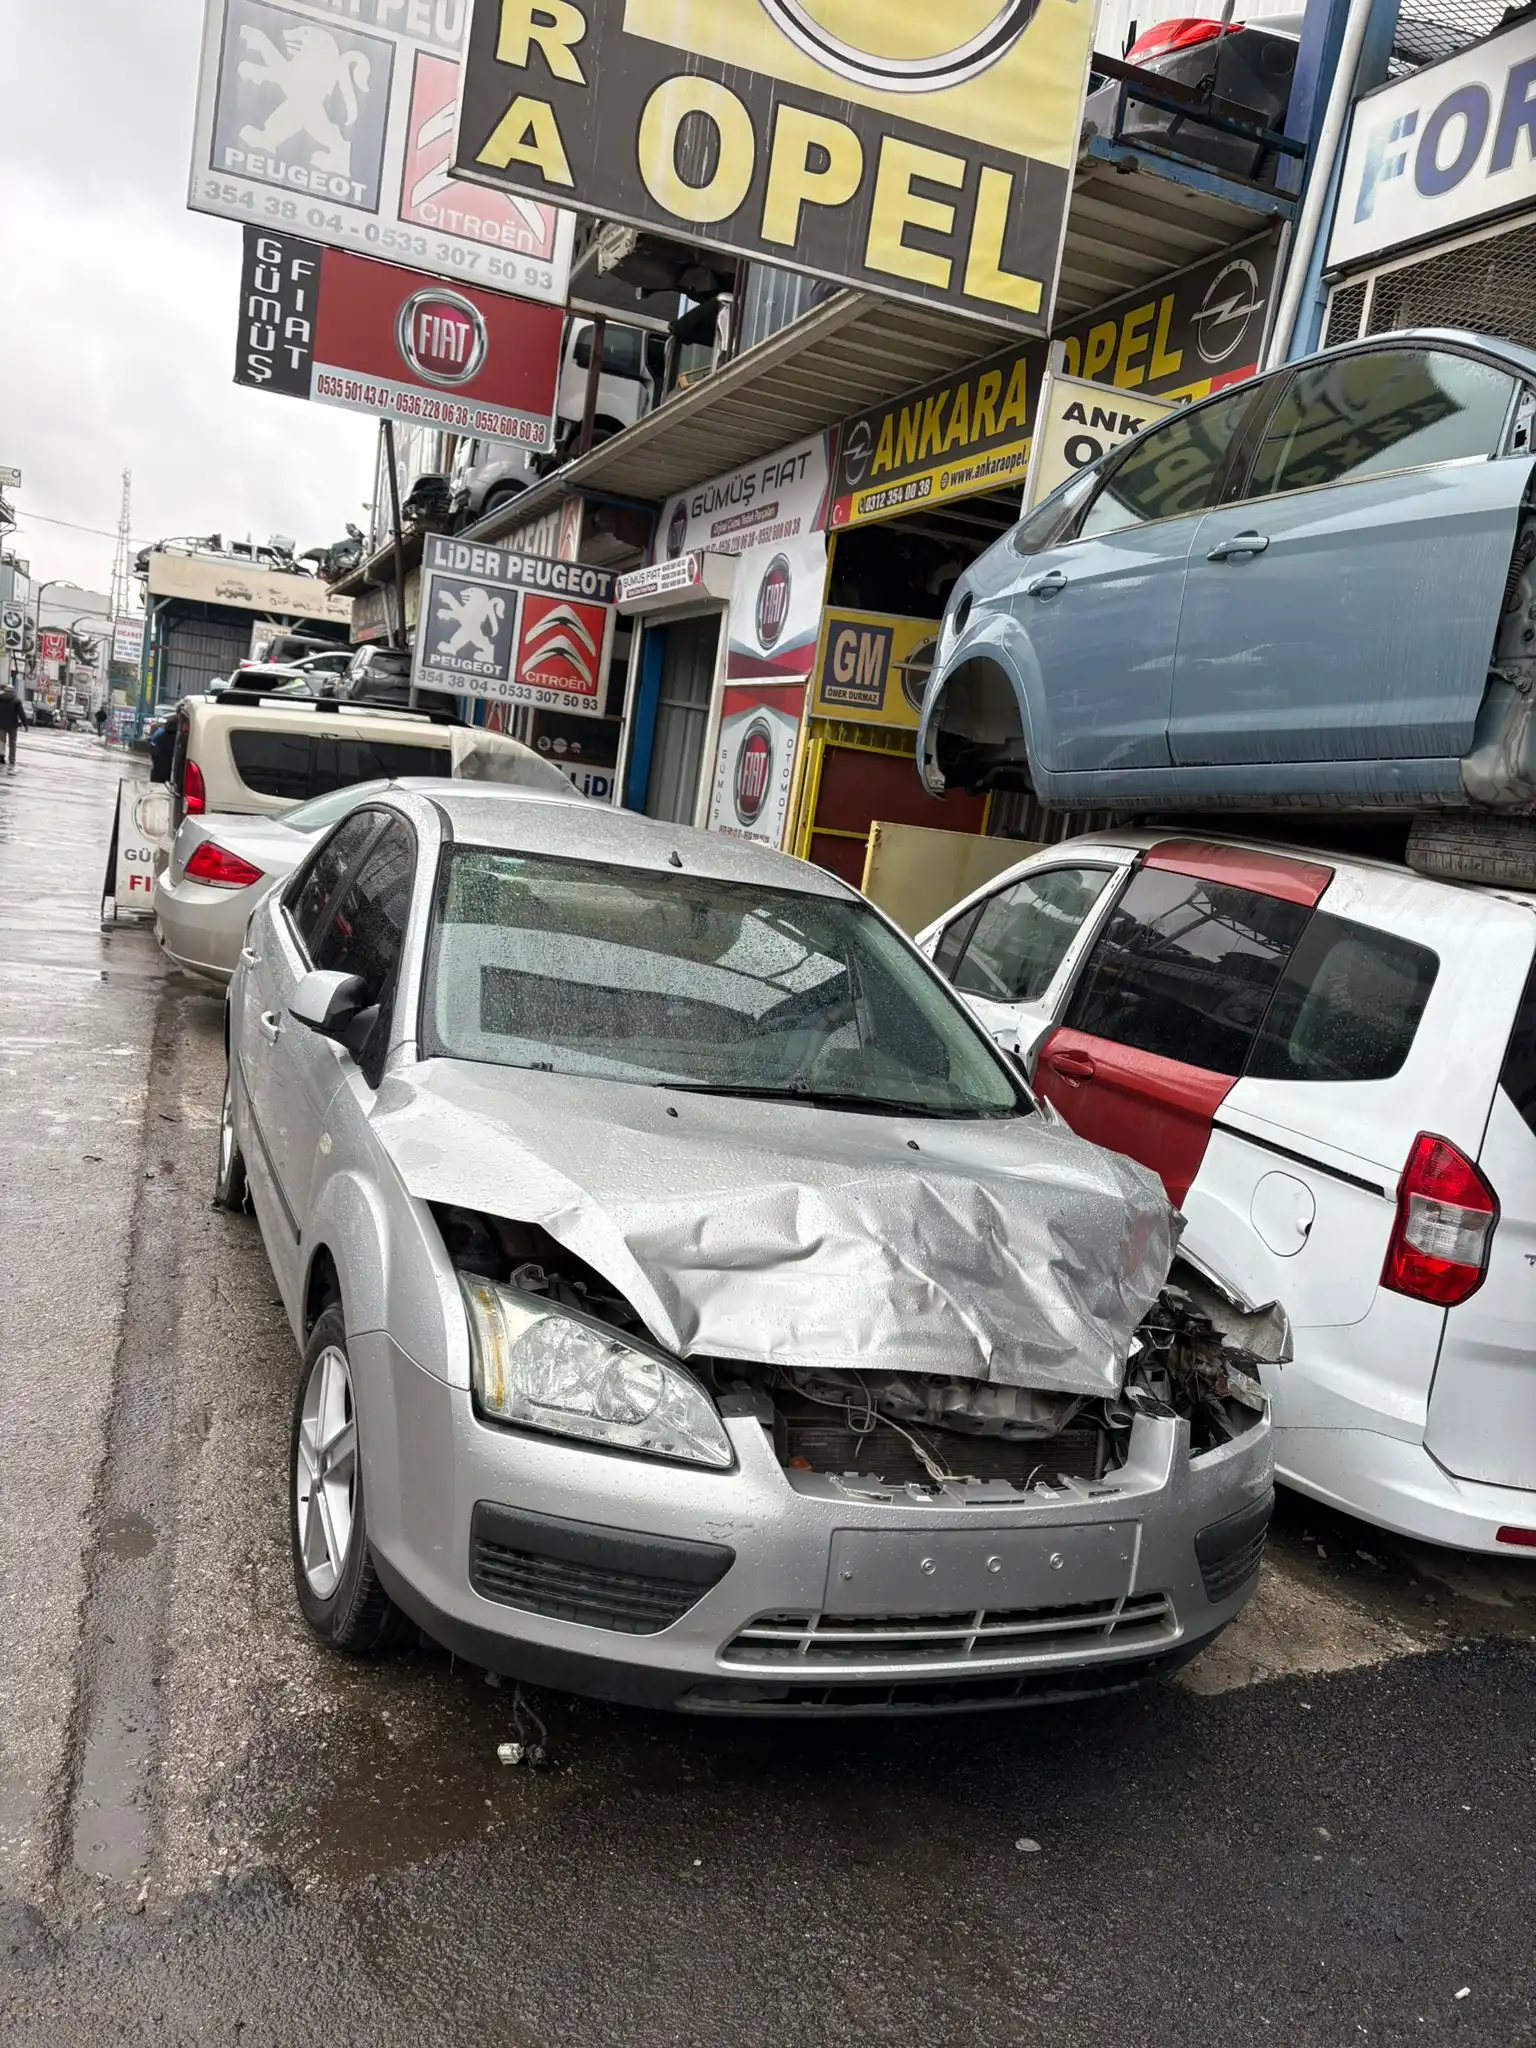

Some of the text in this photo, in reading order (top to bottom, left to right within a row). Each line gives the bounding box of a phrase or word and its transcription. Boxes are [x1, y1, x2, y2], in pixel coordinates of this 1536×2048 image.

[224, 147, 367, 202] PEUGEOT
[637, 74, 1044, 315] OPEL
[204, 180, 255, 209] 354
[264, 196, 297, 220] 38
[307, 208, 343, 233] 04
[365, 223, 428, 256] 0533
[436, 243, 482, 270] 307
[488, 256, 517, 280] 50
[524, 267, 553, 290] 93
[247, 238, 283, 383] GÜMÜŞ
[284, 259, 315, 369] FIAT
[418, 313, 470, 363] FIAT
[317, 373, 546, 444] 0535 501 43 47 0536 228 06 38 0552 608 60 38
[870, 357, 1027, 476] ANKARA
[691, 451, 812, 519] GÜMÜŞ FIAT
[865, 444, 1030, 512] 0312 354 00 38 www.ankaraopel.
[506, 555, 610, 597] PEUGEOT
[429, 653, 503, 676] PEUGEOT
[833, 629, 886, 687] GM
[417, 668, 444, 685] 354
[447, 674, 465, 688] 38
[469, 678, 488, 693] 04
[498, 683, 532, 700] 0533
[535, 689, 559, 705] 307
[562, 693, 579, 708] 50
[582, 696, 599, 711] 93
[848, 690, 878, 703] DURMAZ
[741, 751, 767, 797] FIAT
[124, 848, 155, 863] GÜ
